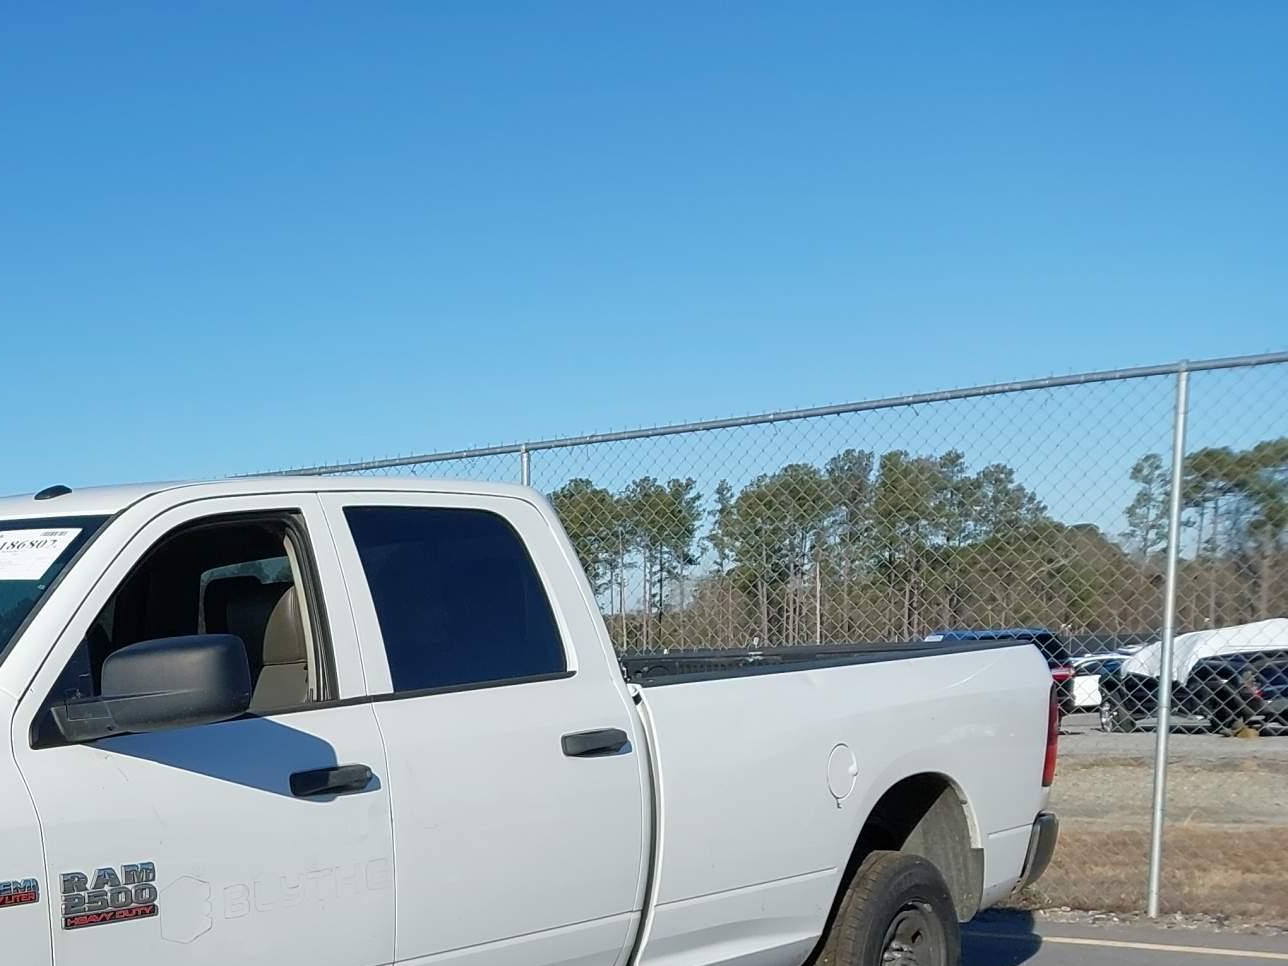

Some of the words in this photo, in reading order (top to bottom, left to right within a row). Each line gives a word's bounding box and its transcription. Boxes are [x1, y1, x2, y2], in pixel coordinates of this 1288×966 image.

[59, 862, 157, 894] RAM
[5, 893, 36, 905] LITER
[61, 883, 159, 915] 2500
[67, 911, 114, 926] HEAVY
[116, 905, 156, 919] DUTY
